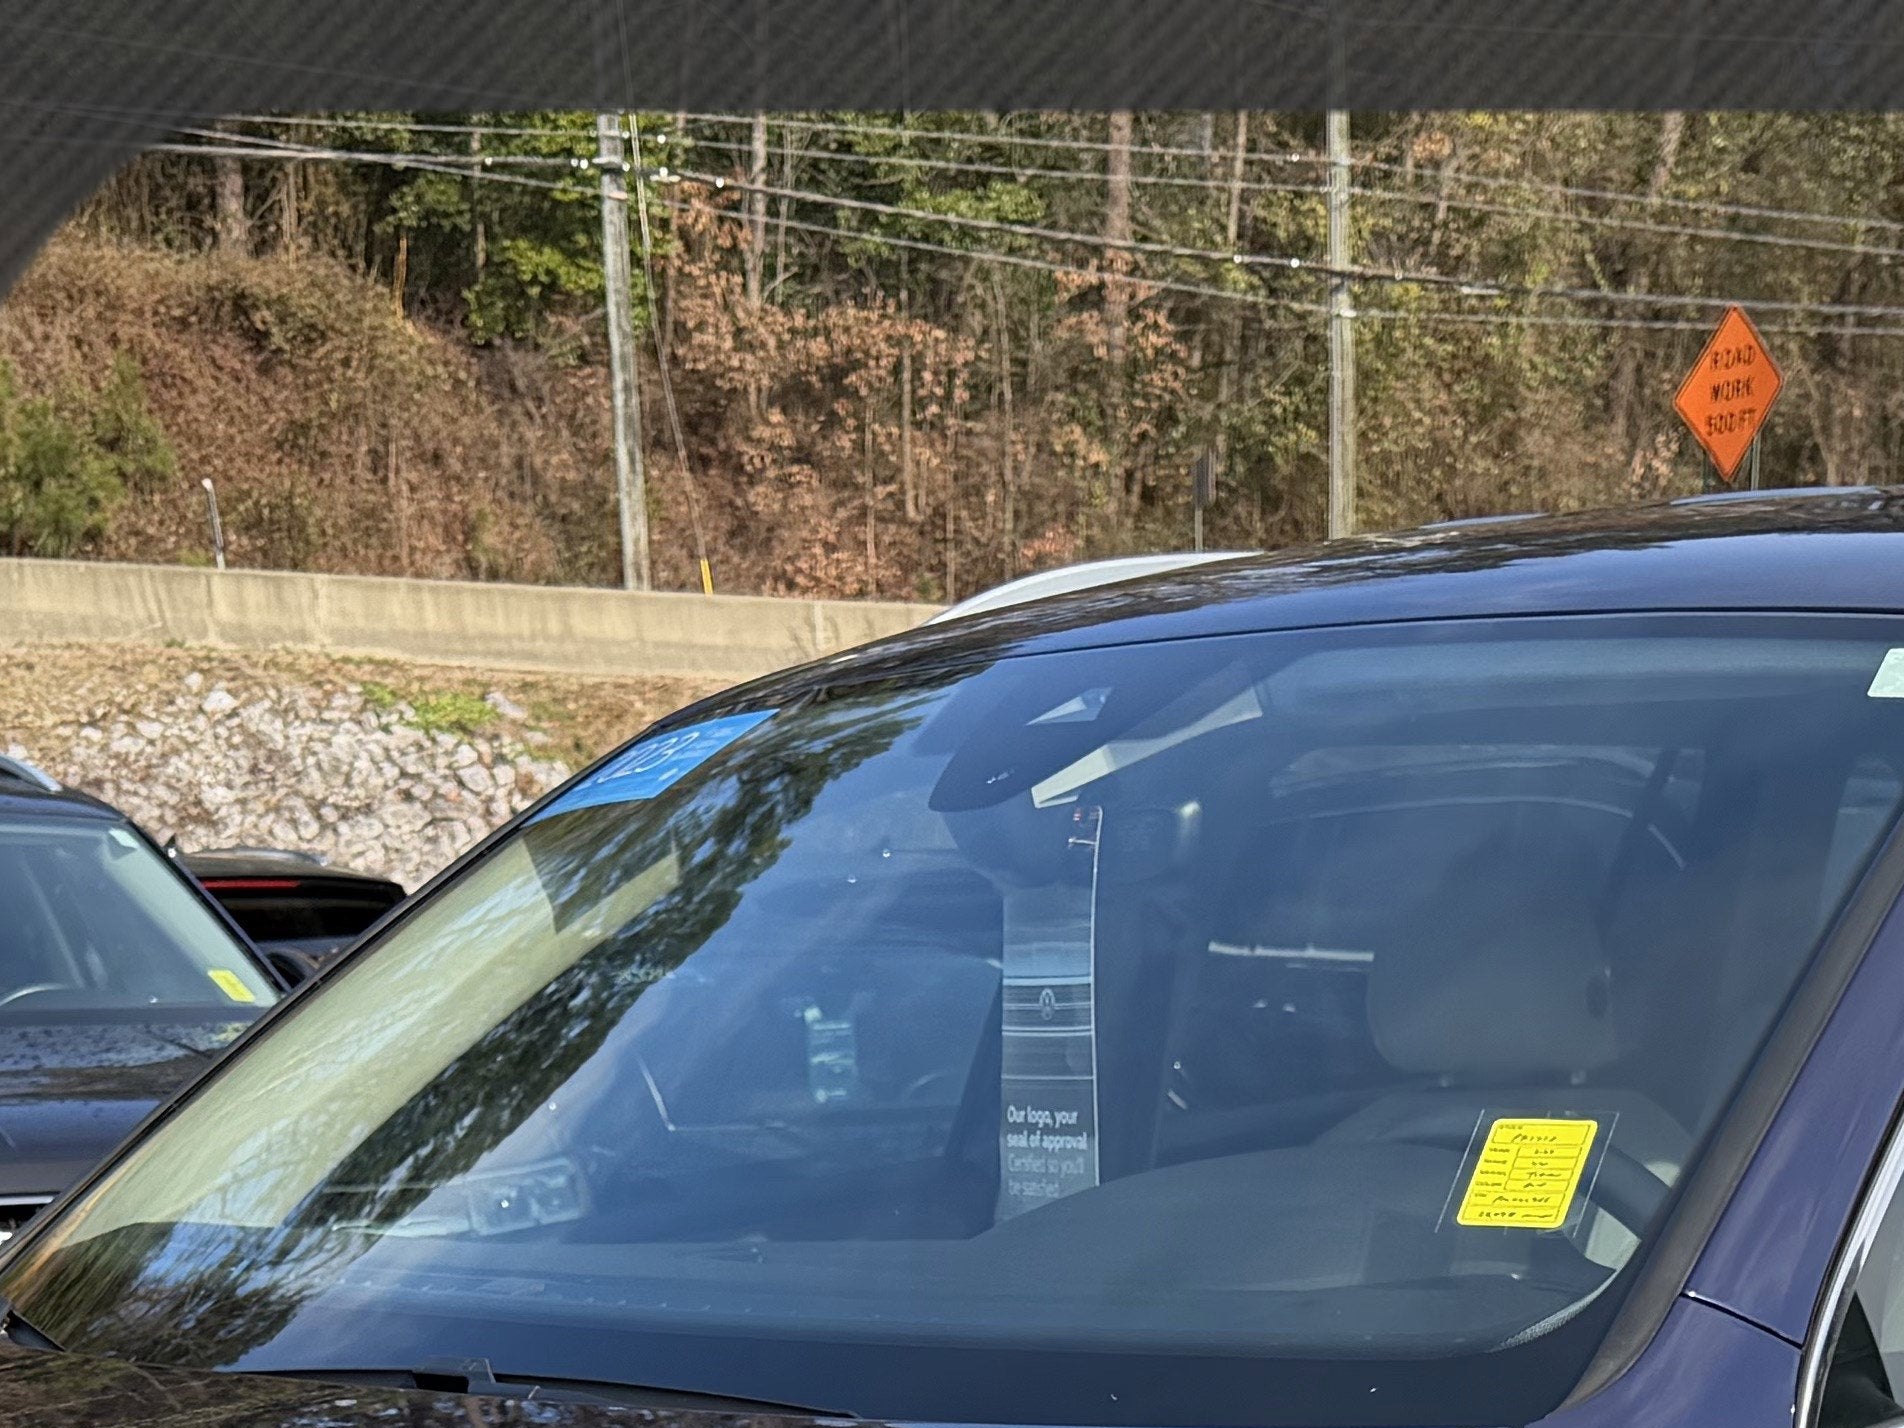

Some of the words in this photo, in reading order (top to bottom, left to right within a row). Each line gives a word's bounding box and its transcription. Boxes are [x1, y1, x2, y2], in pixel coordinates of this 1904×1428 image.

[1711, 345, 1755, 370] ROAD
[1711, 376, 1753, 401] WORK
[1007, 1104, 1026, 1123] Our
[1054, 1110, 1078, 1128] your
[1007, 1130, 1028, 1148] seal
[1042, 1131, 1087, 1152] approval
